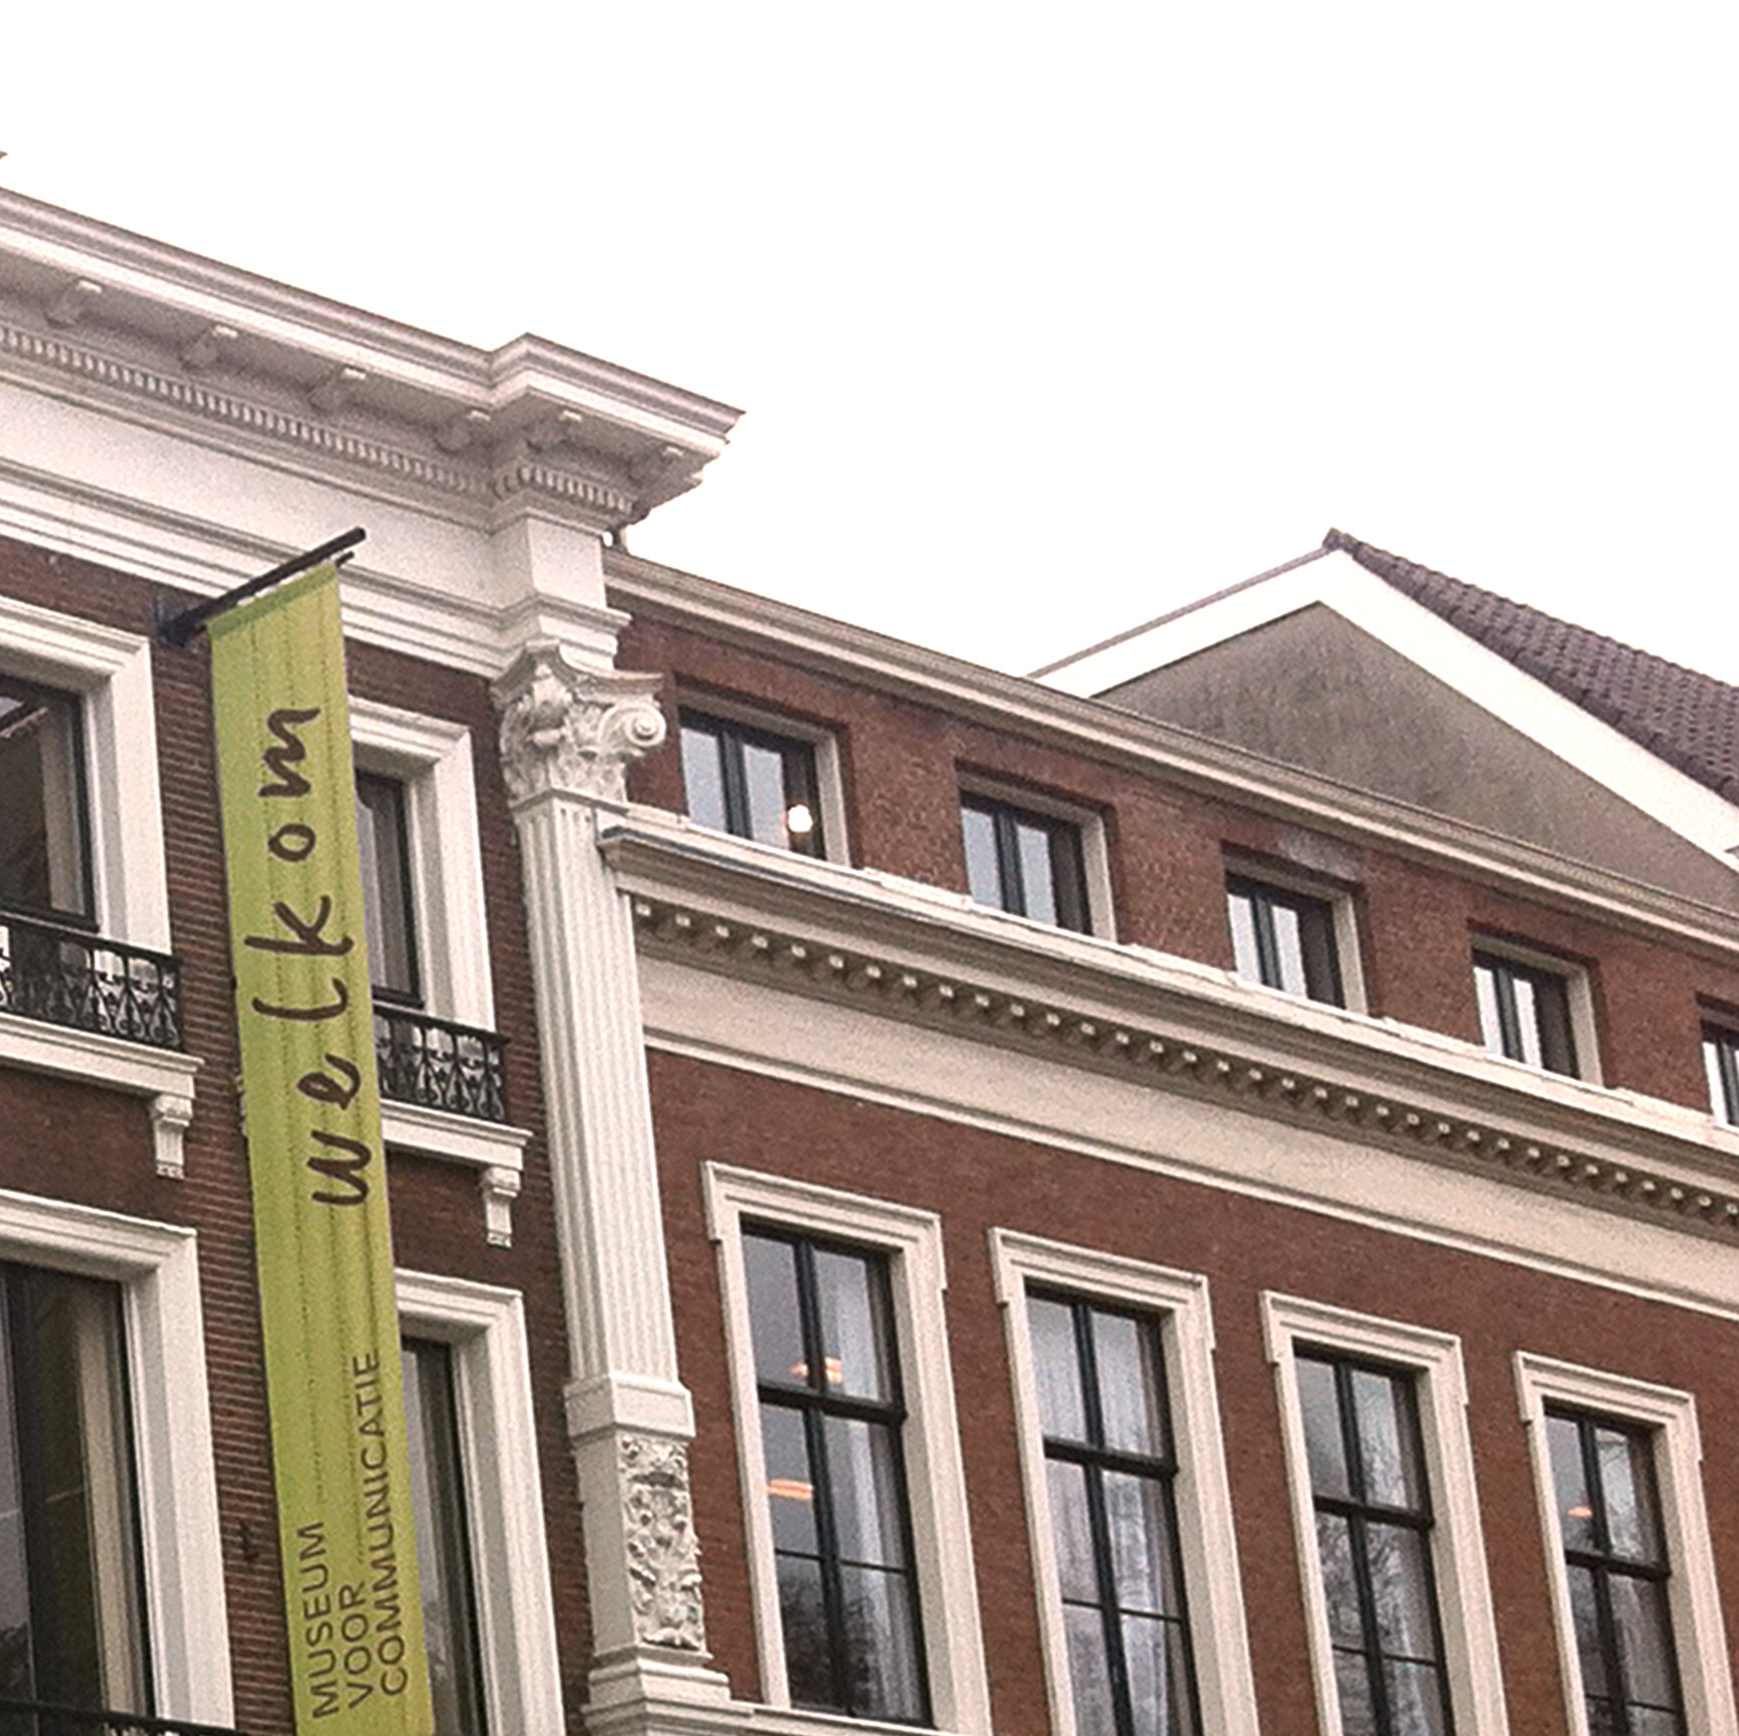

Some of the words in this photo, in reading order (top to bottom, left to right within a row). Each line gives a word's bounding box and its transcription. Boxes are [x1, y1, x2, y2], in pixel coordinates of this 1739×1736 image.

[243, 707, 373, 1206] welkom
[297, 1521, 341, 1720] MUSEUM
[338, 1581, 375, 1709] VOOR
[353, 1351, 409, 1698] COMMUNICATIE
